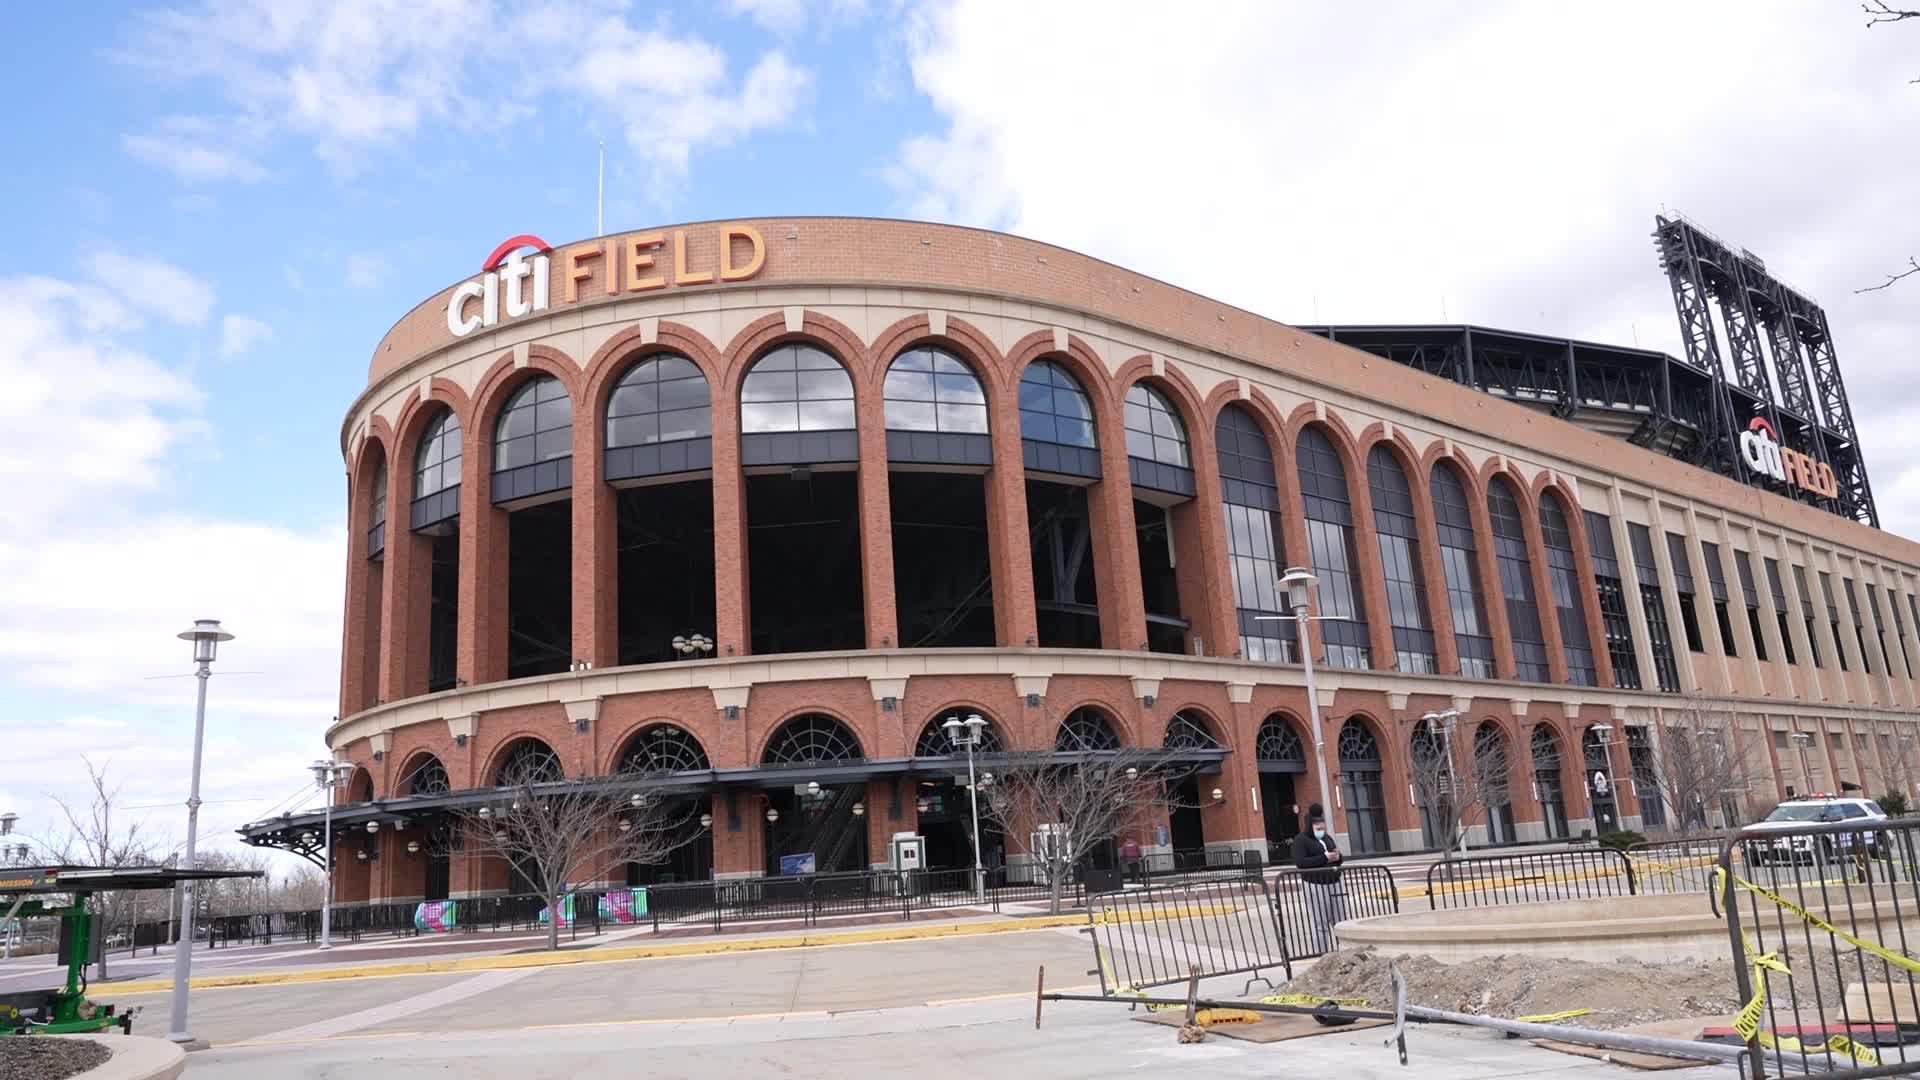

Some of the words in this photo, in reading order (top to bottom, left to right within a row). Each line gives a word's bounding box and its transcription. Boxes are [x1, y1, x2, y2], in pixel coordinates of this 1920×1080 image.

[447, 247, 550, 337] citi
[565, 226, 766, 304] FIELD
[1780, 446, 1838, 499] FIELD
